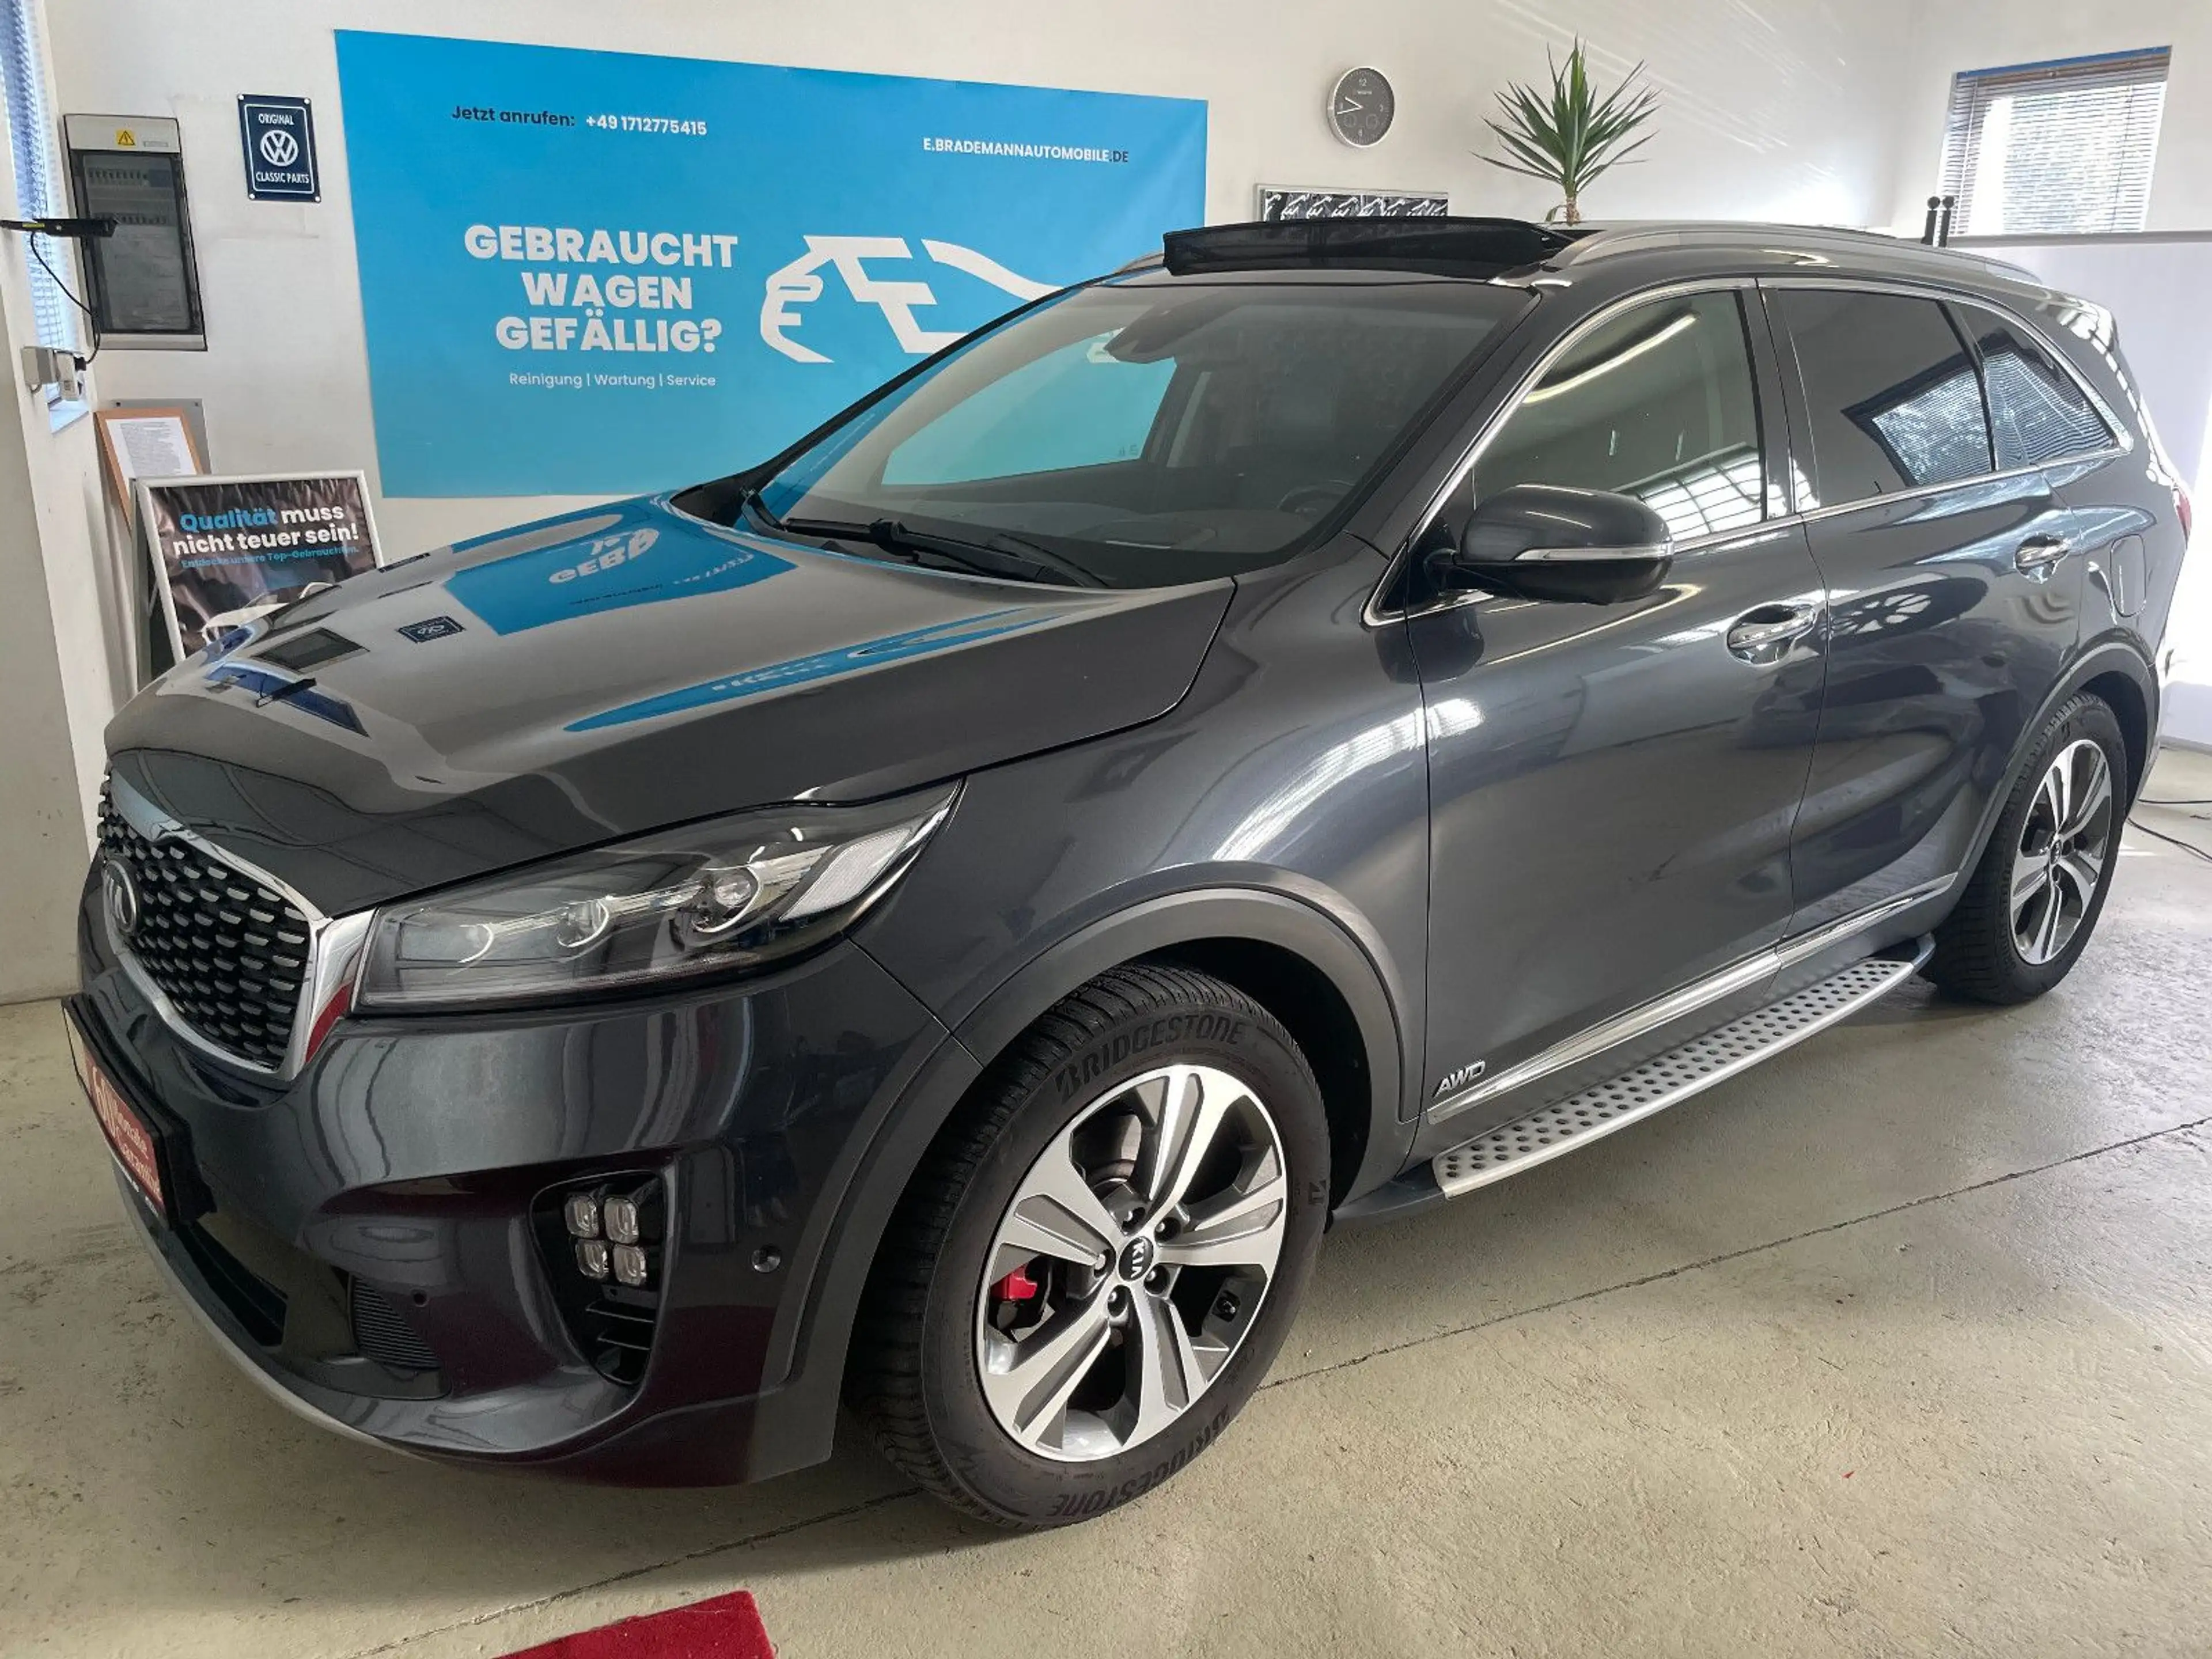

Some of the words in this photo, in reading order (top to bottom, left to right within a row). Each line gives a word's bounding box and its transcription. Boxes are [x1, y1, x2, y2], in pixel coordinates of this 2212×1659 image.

[258, 113, 294, 125] ORIGINAL
[452, 105, 494, 122] Jetzt
[499, 109, 575, 127] anrufen:
[586, 115, 618, 130] +49
[621, 116, 707, 135] 1712775415
[923, 137, 1129, 163] E.BRADEMANNAUTOMOBILE.DE
[256, 172, 286, 183] CLASSIC
[287, 173, 309, 184] PARTS
[464, 224, 738, 268] GEBRAUCHT
[521, 272, 692, 309] WAGEN
[496, 308, 722, 353] GEFÄLLIG?
[509, 373, 583, 388] Reinigung
[594, 374, 656, 389] Wartung
[666, 374, 716, 387] Service
[180, 507, 278, 533] Qualität
[281, 506, 344, 524] muss
[173, 533, 234, 559] nicht
[237, 531, 301, 550] teuer
[305, 522, 359, 544] sein!
[1054, 1014, 1245, 1101] BRIDGESTONE
[1433, 1060, 1486, 1099] AWD
[1131, 1241, 1144, 1278] KIA
